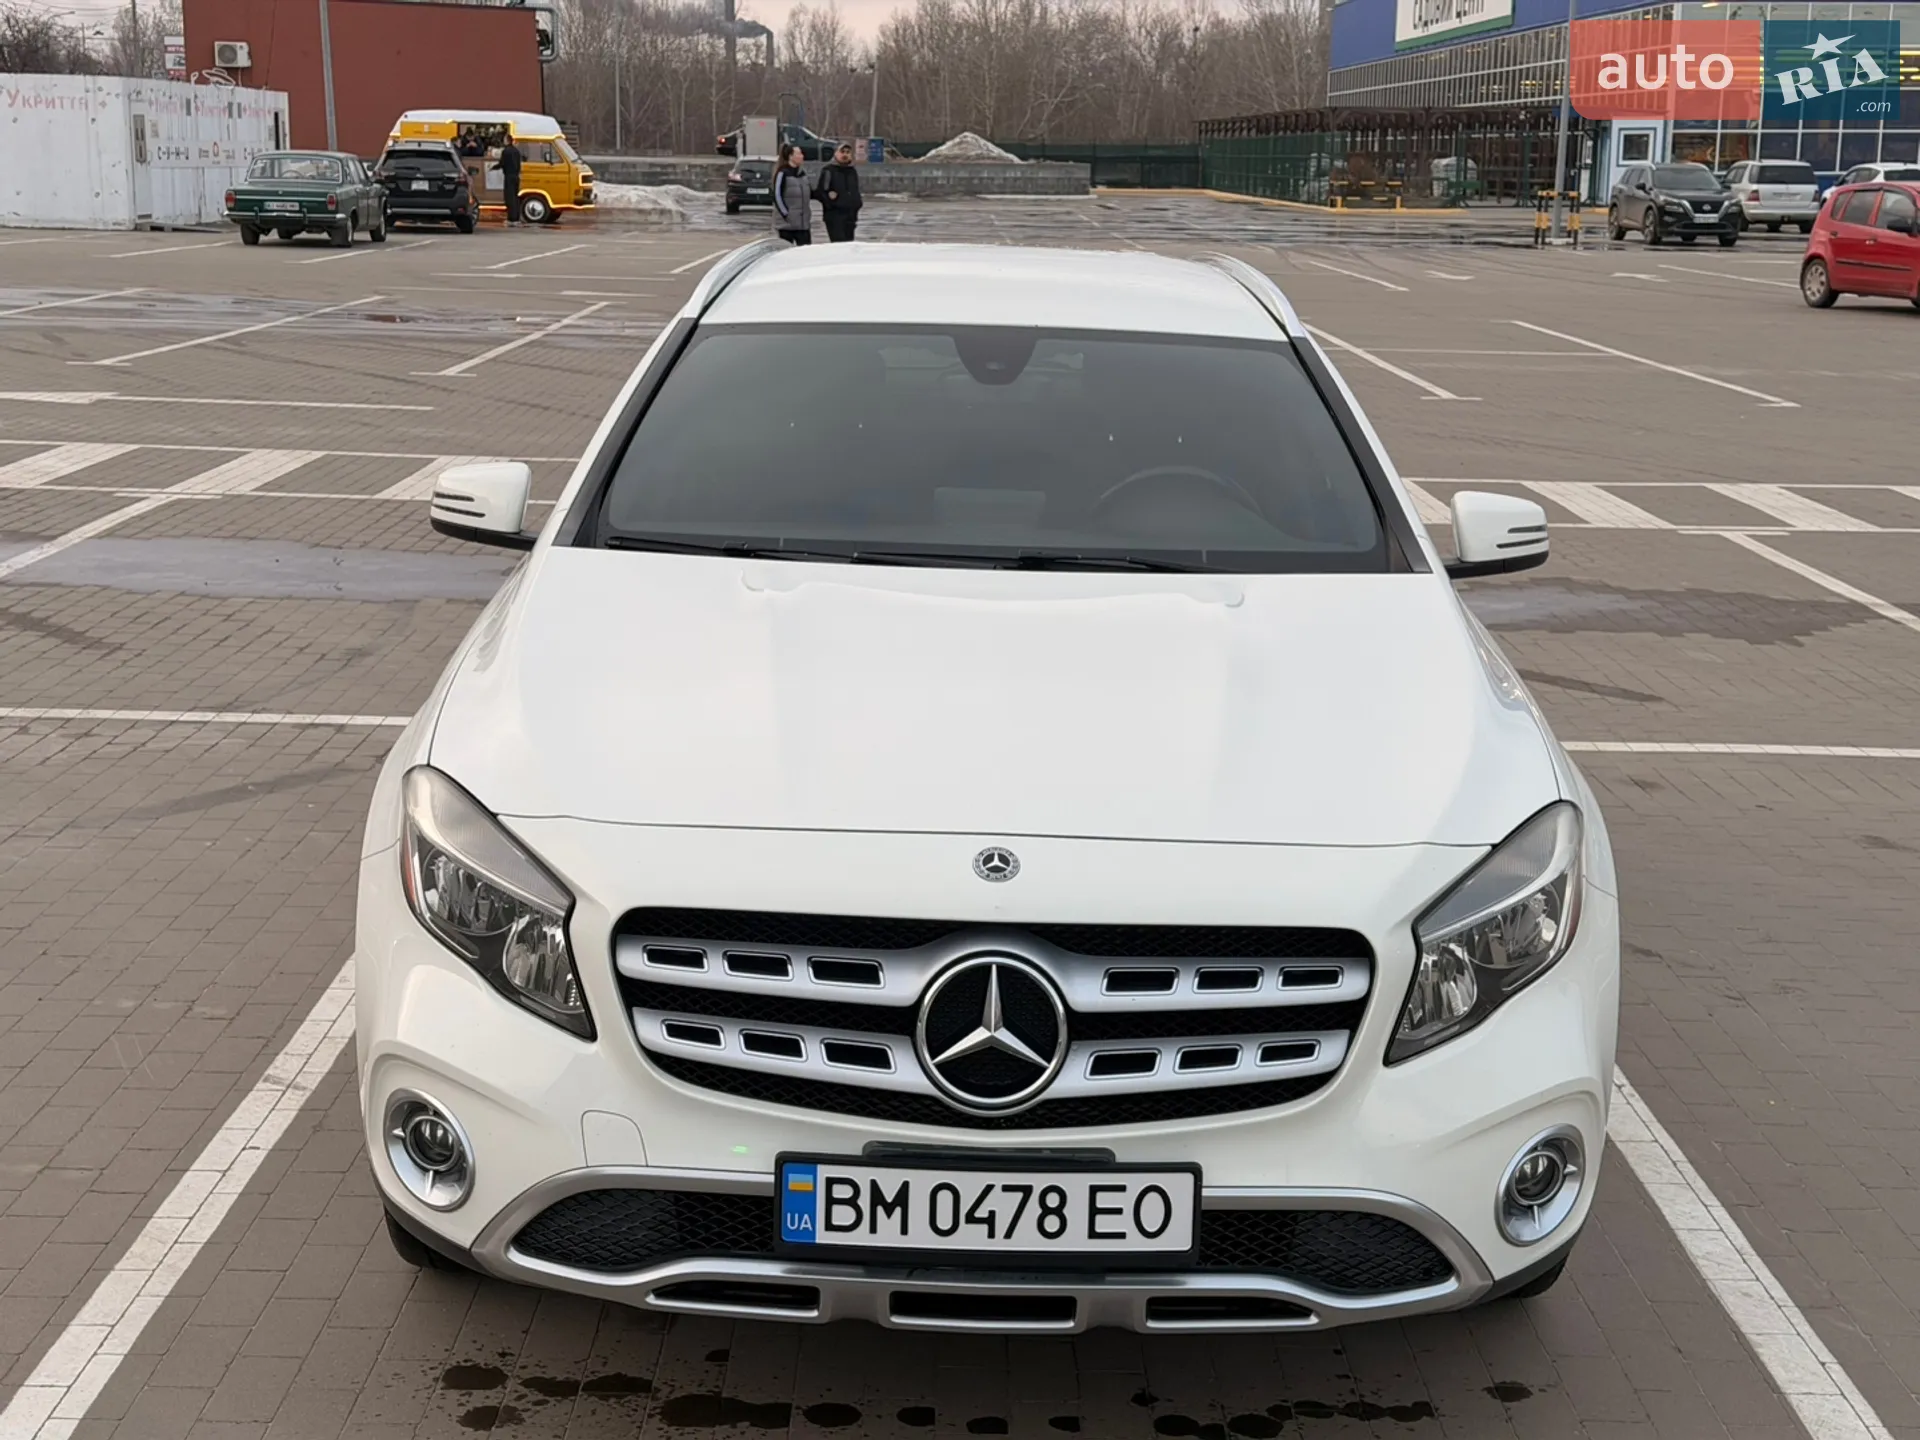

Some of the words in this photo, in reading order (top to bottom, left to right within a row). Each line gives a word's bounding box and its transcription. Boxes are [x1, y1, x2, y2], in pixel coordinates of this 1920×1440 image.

[787, 1212, 813, 1231] UA
[824, 1176, 909, 1236] BM
[928, 1181, 1068, 1240] 0478
[1087, 1184, 1172, 1240] EO
